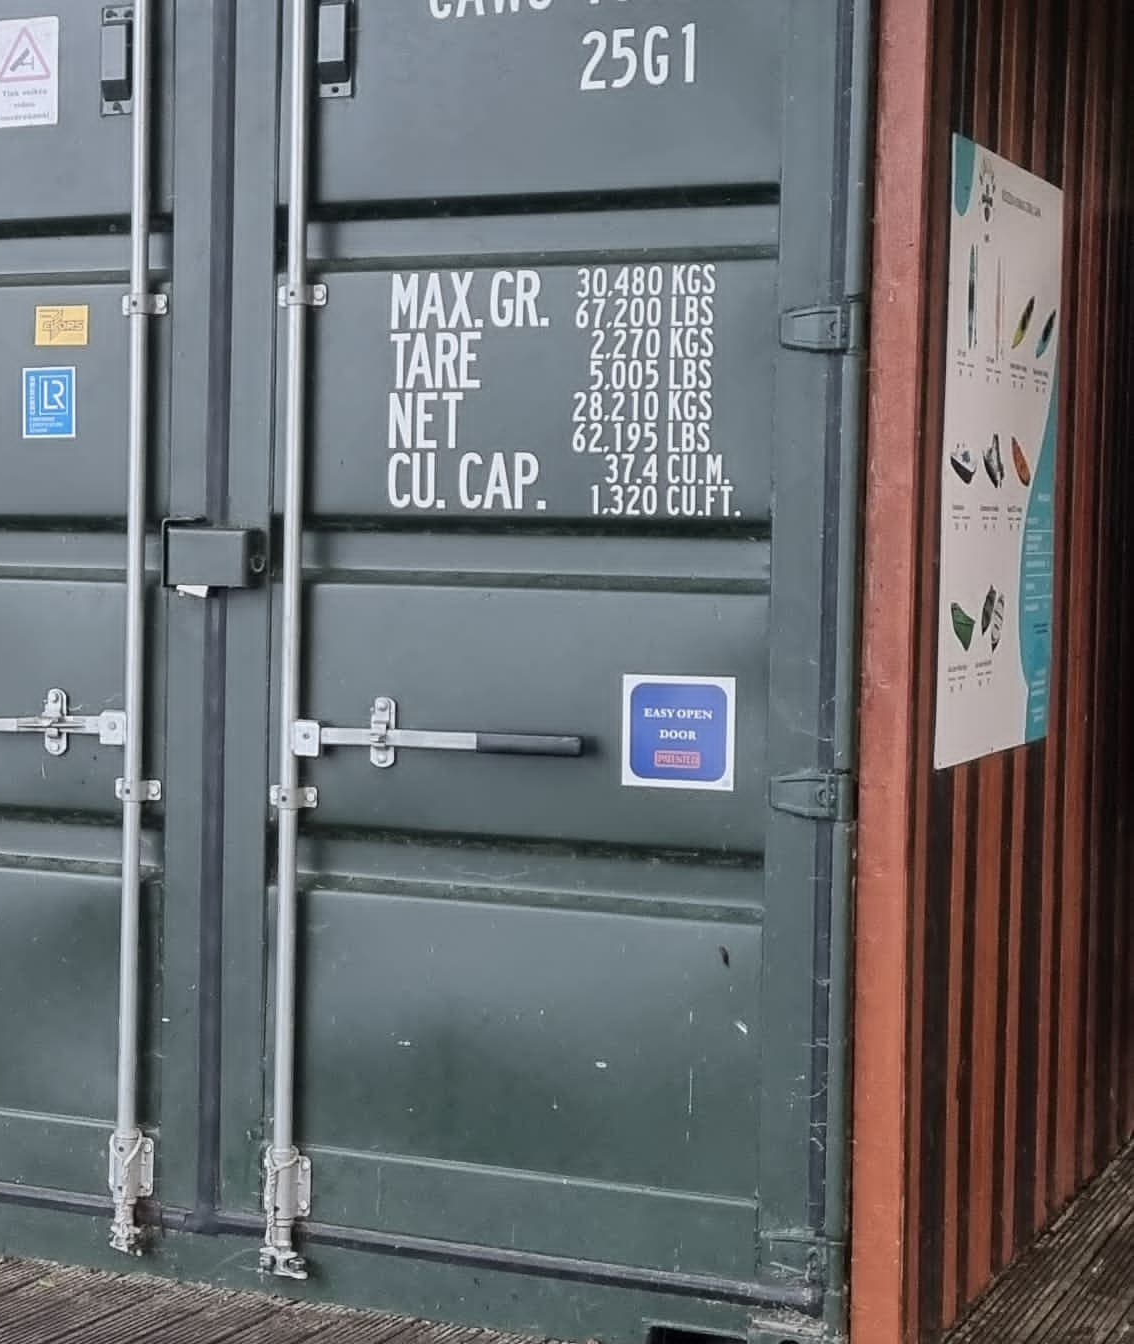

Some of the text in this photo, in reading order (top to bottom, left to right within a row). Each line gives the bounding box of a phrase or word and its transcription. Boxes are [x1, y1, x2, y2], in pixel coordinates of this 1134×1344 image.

[580, 22, 696, 91] 25G1
[576, 264, 716, 299] 30,480 KGS
[575, 296, 714, 329] 67,200 LBS
[590, 327, 714, 360] 2,270 KGS
[390, 332, 482, 390] TARE
[589, 359, 712, 390] 5,005 LBS
[43, 379, 66, 410] LR
[572, 391, 713, 423] 28,210 KGS
[388, 392, 464, 450] NET
[571, 422, 711, 454] 62,195 LBS
[387, 452, 547, 511] CU. CAP.
[604, 454, 730, 485] 37.4 CU.M.
[590, 485, 741, 517] 1,320 CU.FT.
[643, 707, 713, 720] EASY OPEN
[659, 729, 697, 741] DOOR
